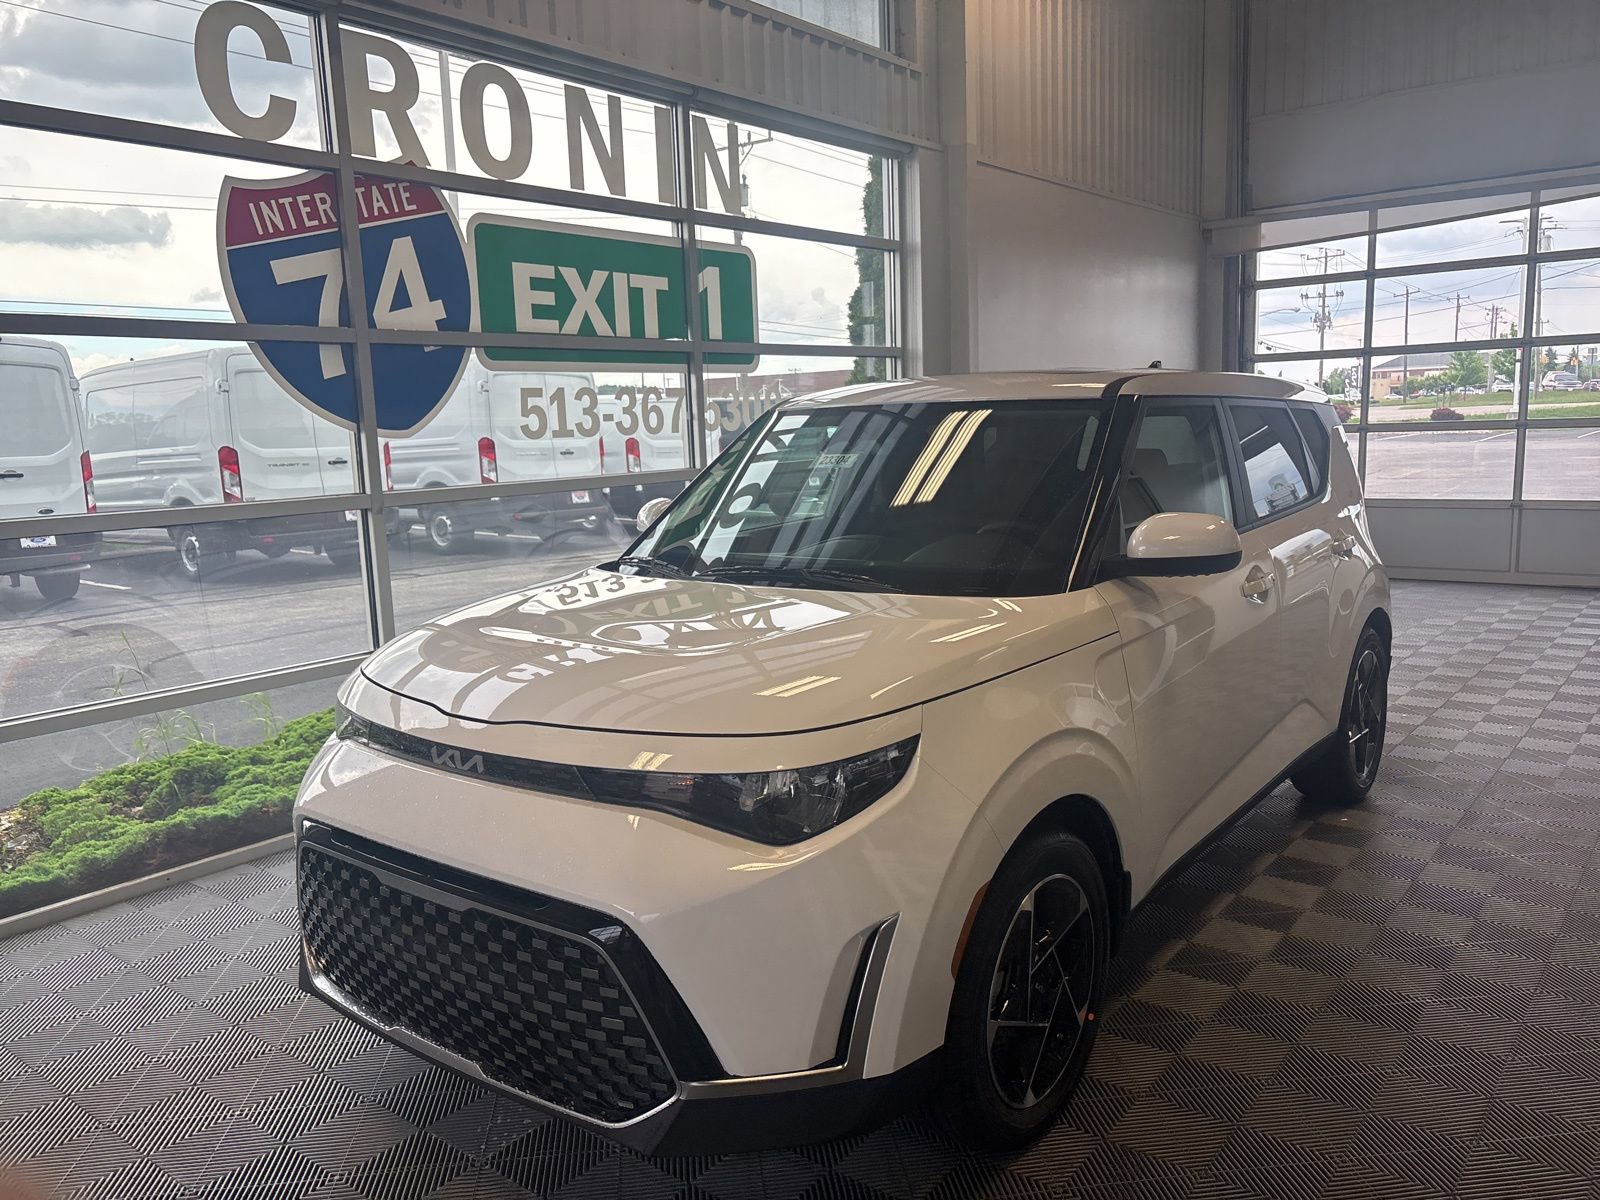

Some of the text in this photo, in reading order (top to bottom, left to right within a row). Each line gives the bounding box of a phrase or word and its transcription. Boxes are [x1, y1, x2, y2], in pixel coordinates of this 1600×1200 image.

[194, 0, 741, 214] CRONIN
[249, 182, 417, 235] INTERTATE
[269, 235, 447, 380] 74
[511, 262, 723, 340] EXIT 1
[819, 455, 852, 465] 23304
[431, 745, 484, 773] KIA
